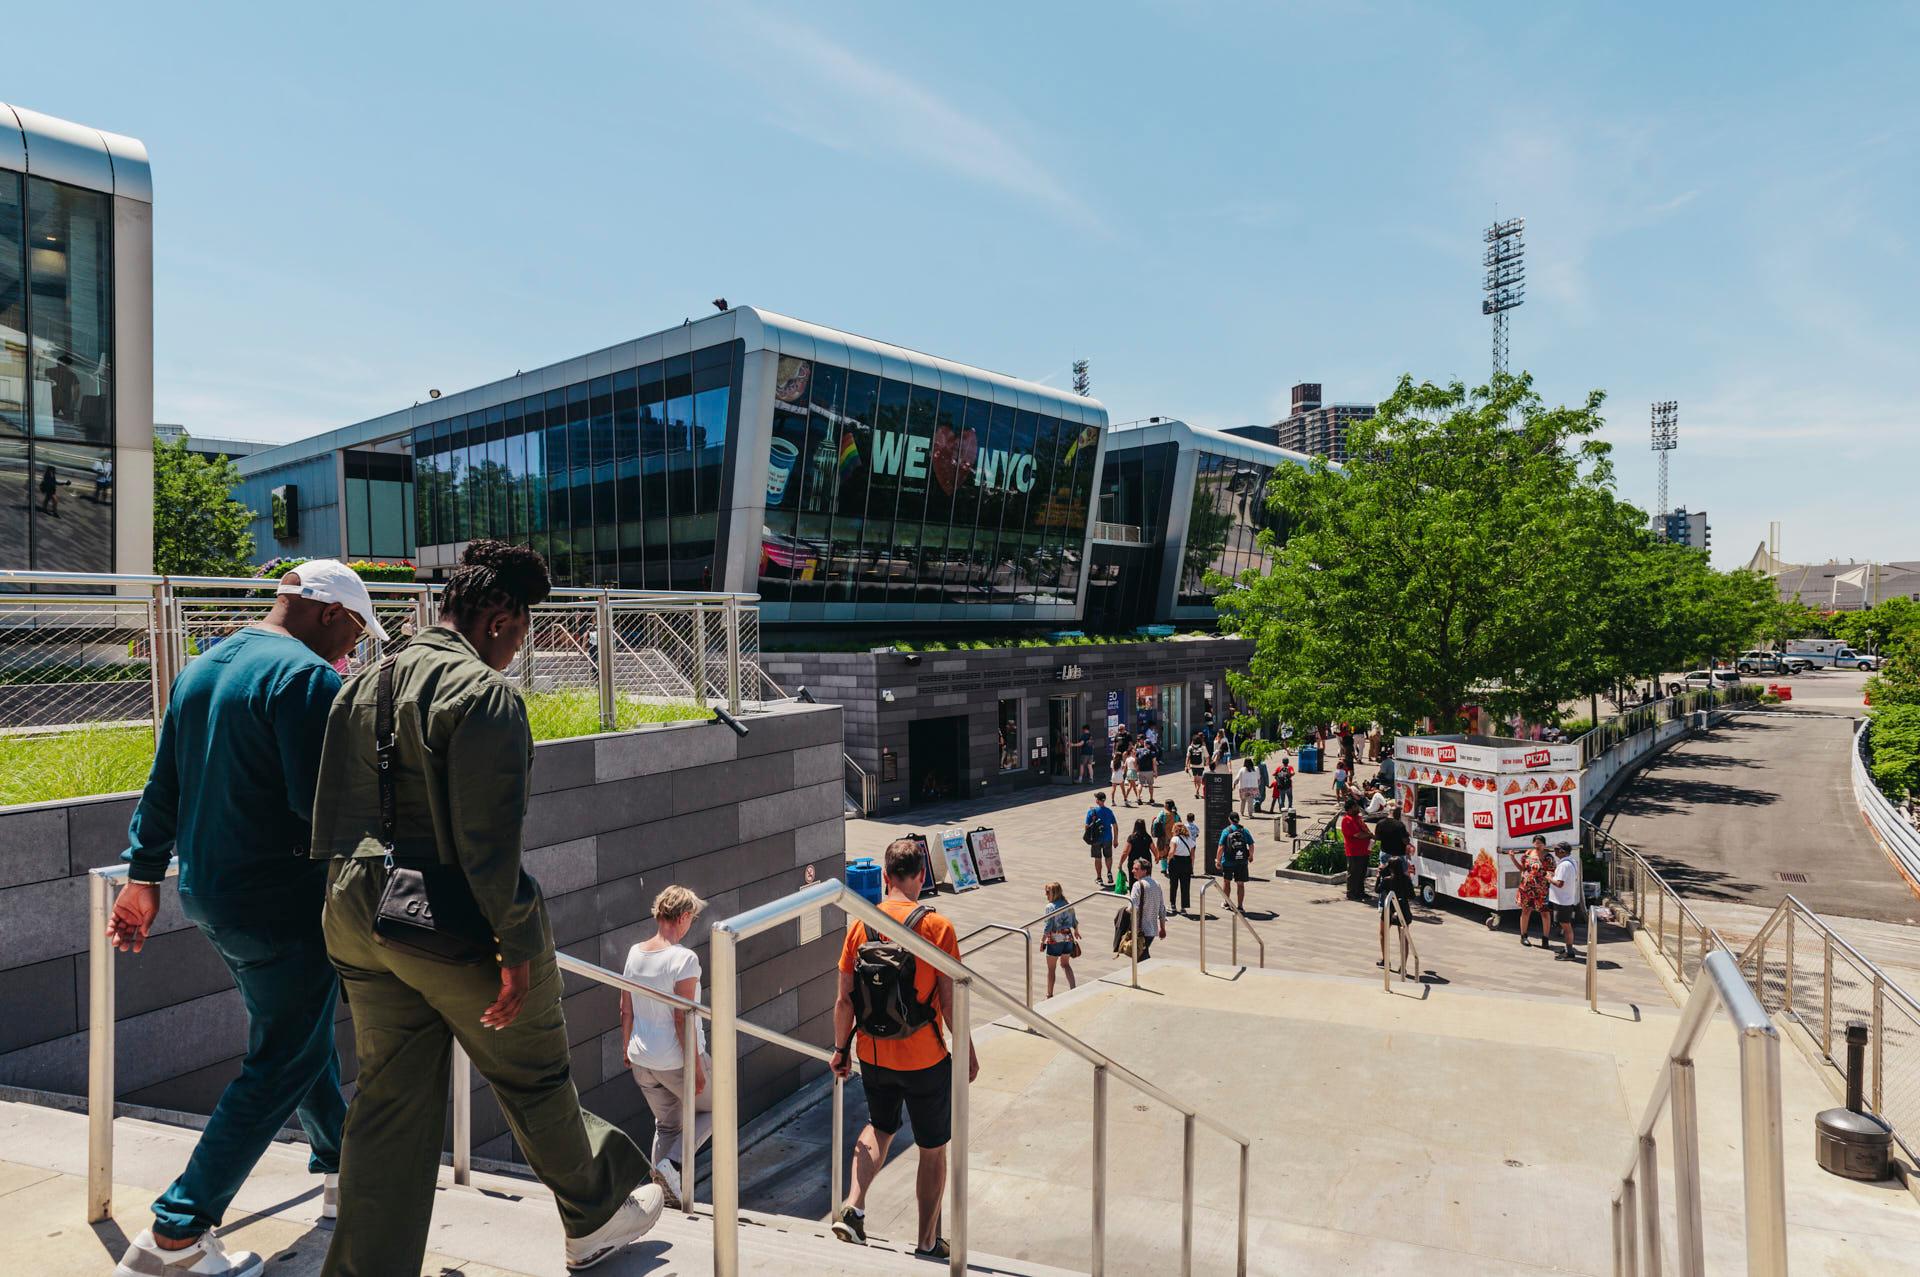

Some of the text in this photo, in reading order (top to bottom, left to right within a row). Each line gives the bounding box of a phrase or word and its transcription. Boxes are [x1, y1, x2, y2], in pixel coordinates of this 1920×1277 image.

[871, 429, 1037, 493] WE NYC
[1406, 745, 1419, 755] NEW
[1420, 746, 1434, 757] YORK
[1438, 748, 1455, 759] PIZZA
[1526, 752, 1549, 765] PIZZA
[1509, 797, 1568, 828] PIZZA
[1474, 814, 1492, 826] PIZZA
